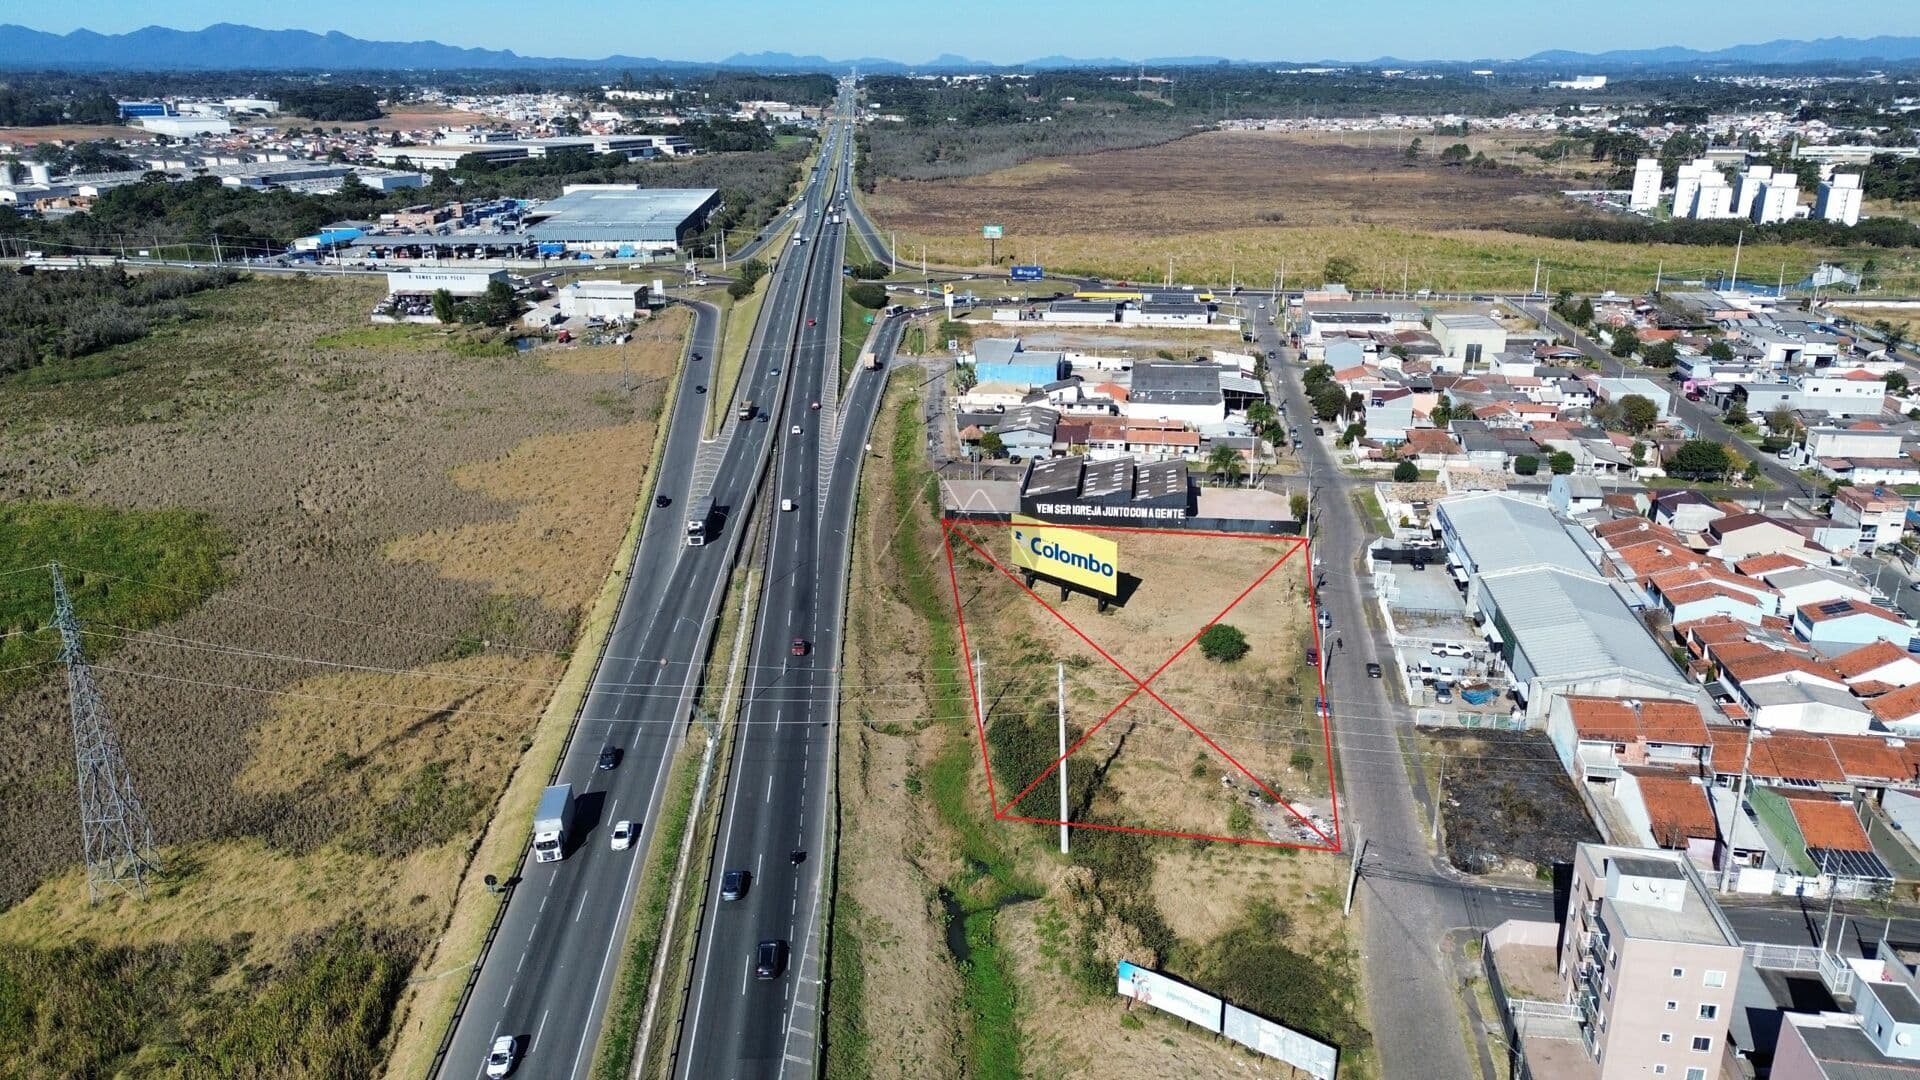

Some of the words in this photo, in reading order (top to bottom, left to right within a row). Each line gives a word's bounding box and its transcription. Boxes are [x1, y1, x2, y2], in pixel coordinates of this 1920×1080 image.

[1036, 503, 1054, 514] VEM
[1054, 504, 1071, 515] SER
[1072, 505, 1102, 516] IGREJA
[1103, 506, 1130, 517] JUNTO
[1130, 507, 1148, 518] COM
[1148, 508, 1154, 518] A
[1155, 508, 1185, 519] GENTE
[1030, 537, 1114, 577] Colombo
